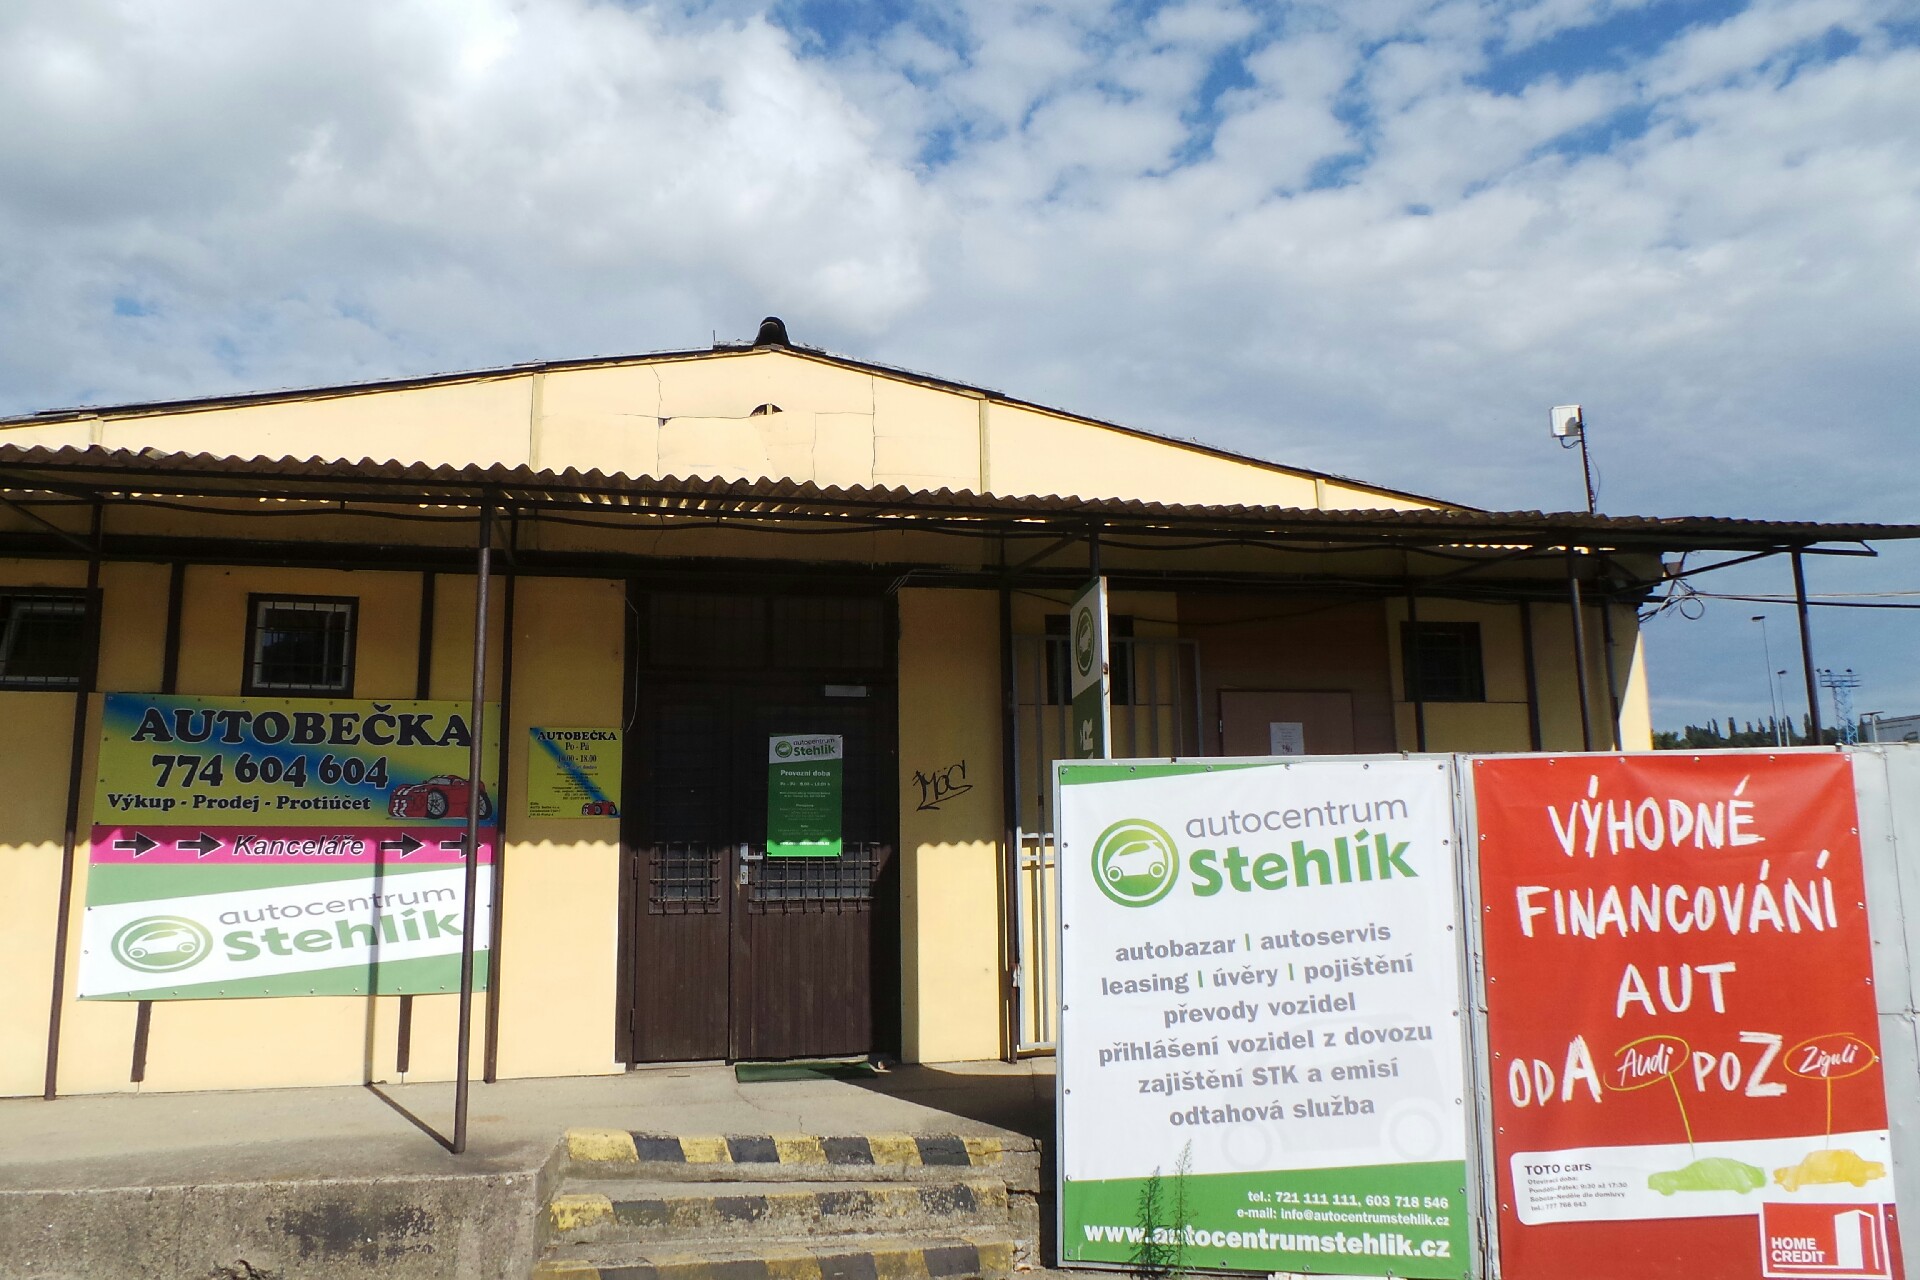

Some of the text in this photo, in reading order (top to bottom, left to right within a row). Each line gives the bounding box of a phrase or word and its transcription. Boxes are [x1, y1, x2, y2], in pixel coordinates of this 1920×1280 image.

[131, 704, 471, 746] AUTOBEČKA
[537, 730, 617, 741] AUTOBEČKA
[793, 738, 835, 746] autocentrum
[565, 742, 574, 751] Po
[152, 752, 389, 789] 774 604 604
[108, 794, 176, 811] Výkup
[193, 795, 260, 812] Prodej
[276, 795, 371, 811] Protiúčet
[1186, 799, 1408, 839] autocentrum
[1547, 774, 1766, 858] VÝHODNÉ
[232, 834, 366, 856] Kanceláře
[1189, 827, 1419, 897] Stehlík
[219, 888, 456, 925] autocentrum
[1515, 849, 1838, 940] FINANCOVÁNÍ
[223, 908, 463, 962] Stehlík
[1115, 937, 1236, 962] autobazar
[1260, 923, 1391, 950] autoservis
[1101, 973, 1189, 996] leasing
[1212, 964, 1278, 988] úvěry
[1304, 953, 1413, 984] pojištění
[1616, 962, 1736, 1019] AUT
[1164, 992, 1356, 1028] převody vozidel
[1099, 1025, 1433, 1067] přihlášení vozidel z dovozu
[1617, 1043, 1673, 1086] Audi
[1138, 1057, 1399, 1096] zajištění STK a emisí
[1169, 1095, 1375, 1127] odtahová služba
[1524, 1163, 1592, 1176] TOTO cars
[1237, 1206, 1450, 1226] e-mail: info@autocentrumstehlik.cz
[1248, 1190, 1271, 1202] tel.:
[1275, 1191, 1300, 1203] 721
[1303, 1193, 1329, 1205] 111
[1365, 1194, 1391, 1207] 603
[1395, 1196, 1420, 1208] 718
[1424, 1197, 1449, 1209] 546
[1083, 1223, 1450, 1258] www.autocentrumstehlik.cz
[1771, 1236, 1817, 1250] HOME
[1771, 1250, 1825, 1263] CREDIT
